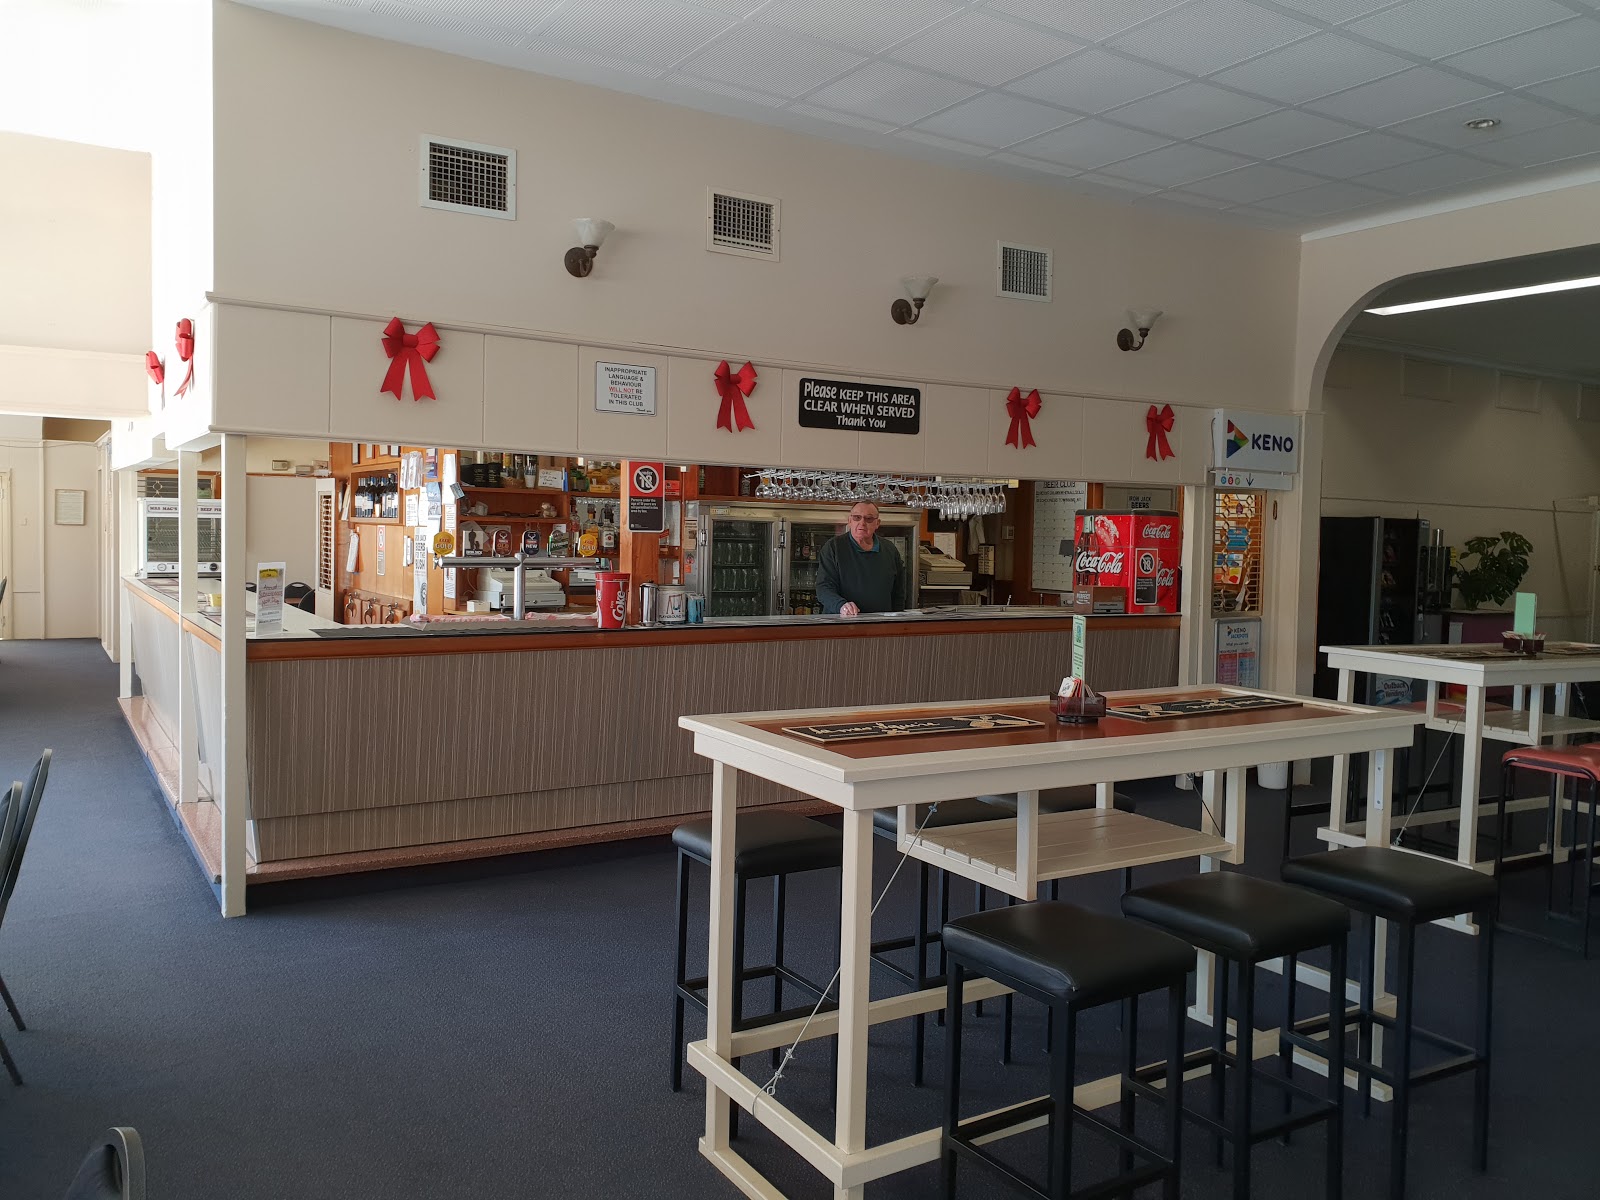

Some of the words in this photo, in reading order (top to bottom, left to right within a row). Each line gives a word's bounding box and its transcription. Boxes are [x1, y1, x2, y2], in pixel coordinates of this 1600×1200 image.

[605, 367, 647, 375] INAPPROPRIATE
[804, 381, 837, 399] Please
[840, 389, 864, 401] KEEP
[866, 391, 889, 403] THIS
[891, 394, 915, 406] AREA
[804, 400, 838, 413] CLEAR
[840, 402, 874, 416] WHEN
[877, 405, 915, 418] SERVED
[836, 415, 866, 427] Thank
[868, 418, 886, 429] You
[1252, 433, 1293, 452] KENO
[639, 475, 653, 488] 18
[1142, 524, 1172, 539] Coca-Cola
[1076, 552, 1125, 573] Coca-Cola
[612, 590, 625, 621] Coke
